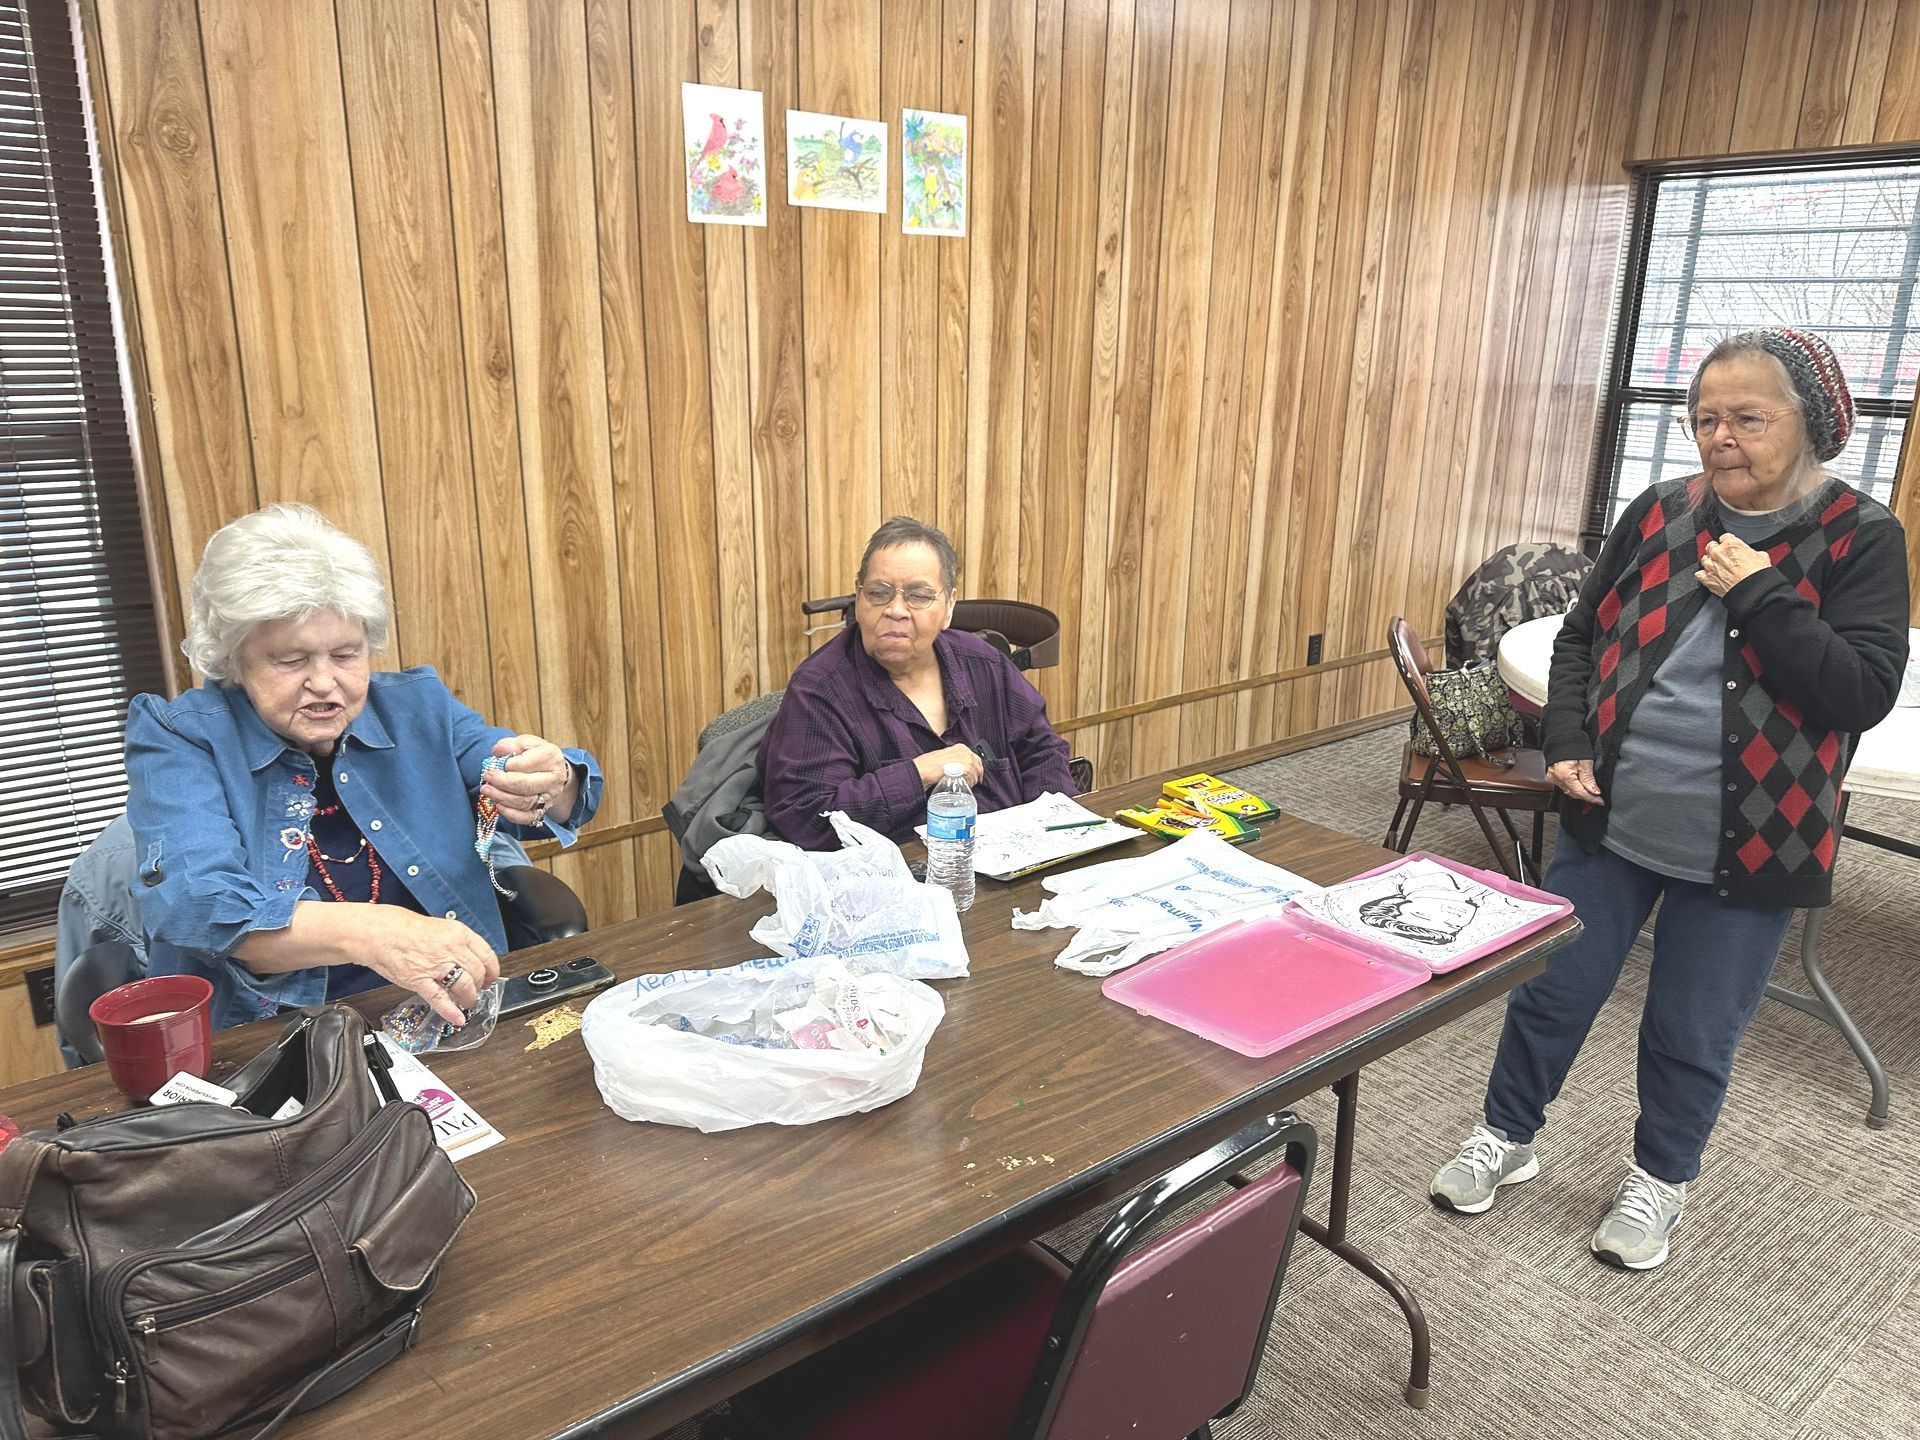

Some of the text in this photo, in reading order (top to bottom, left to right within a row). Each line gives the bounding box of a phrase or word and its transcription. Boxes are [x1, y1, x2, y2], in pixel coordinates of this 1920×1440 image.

[1159, 899, 1203, 932] Walma
[888, 936, 905, 950] STORE
[904, 933, 915, 946] FOR
